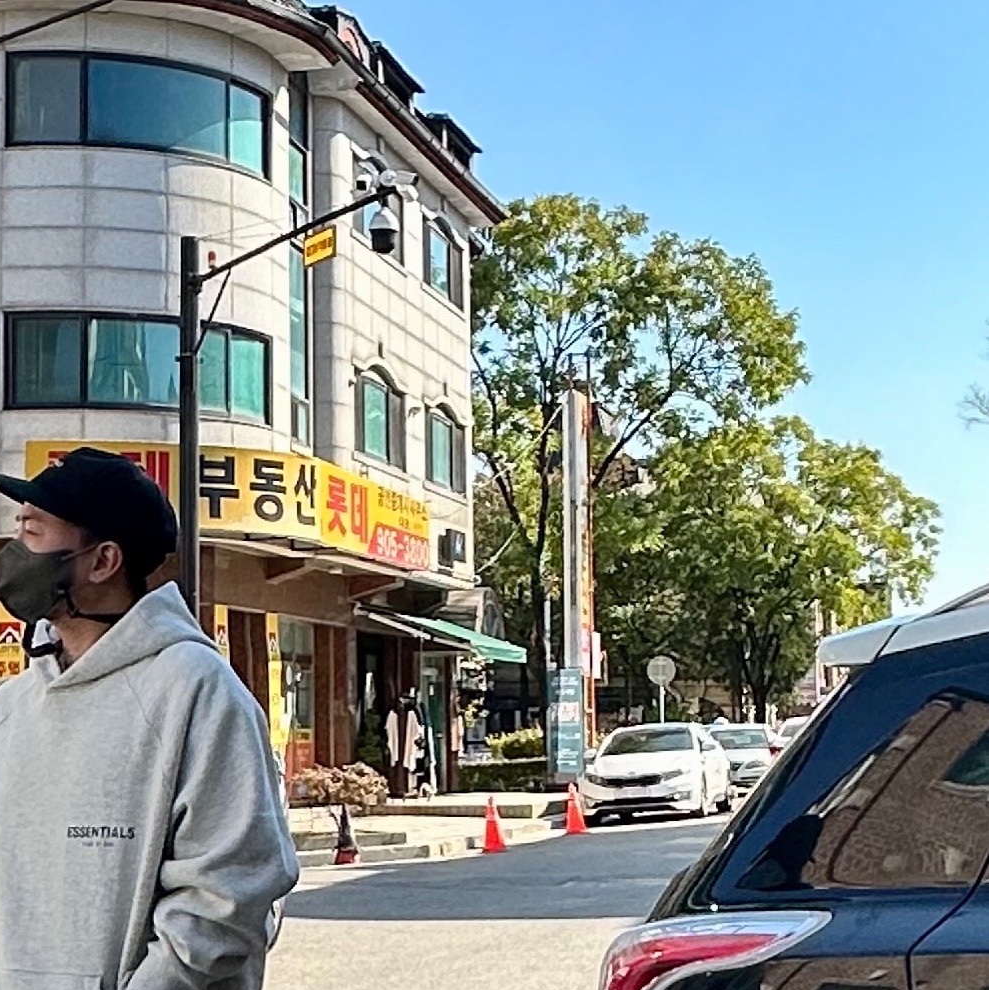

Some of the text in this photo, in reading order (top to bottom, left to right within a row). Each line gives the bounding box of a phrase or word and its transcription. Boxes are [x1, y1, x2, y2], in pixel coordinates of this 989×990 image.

[199, 454, 317, 526] 부동산
[326, 474, 369, 544] 롯데
[67, 826, 136, 840] ESSENTIALS
